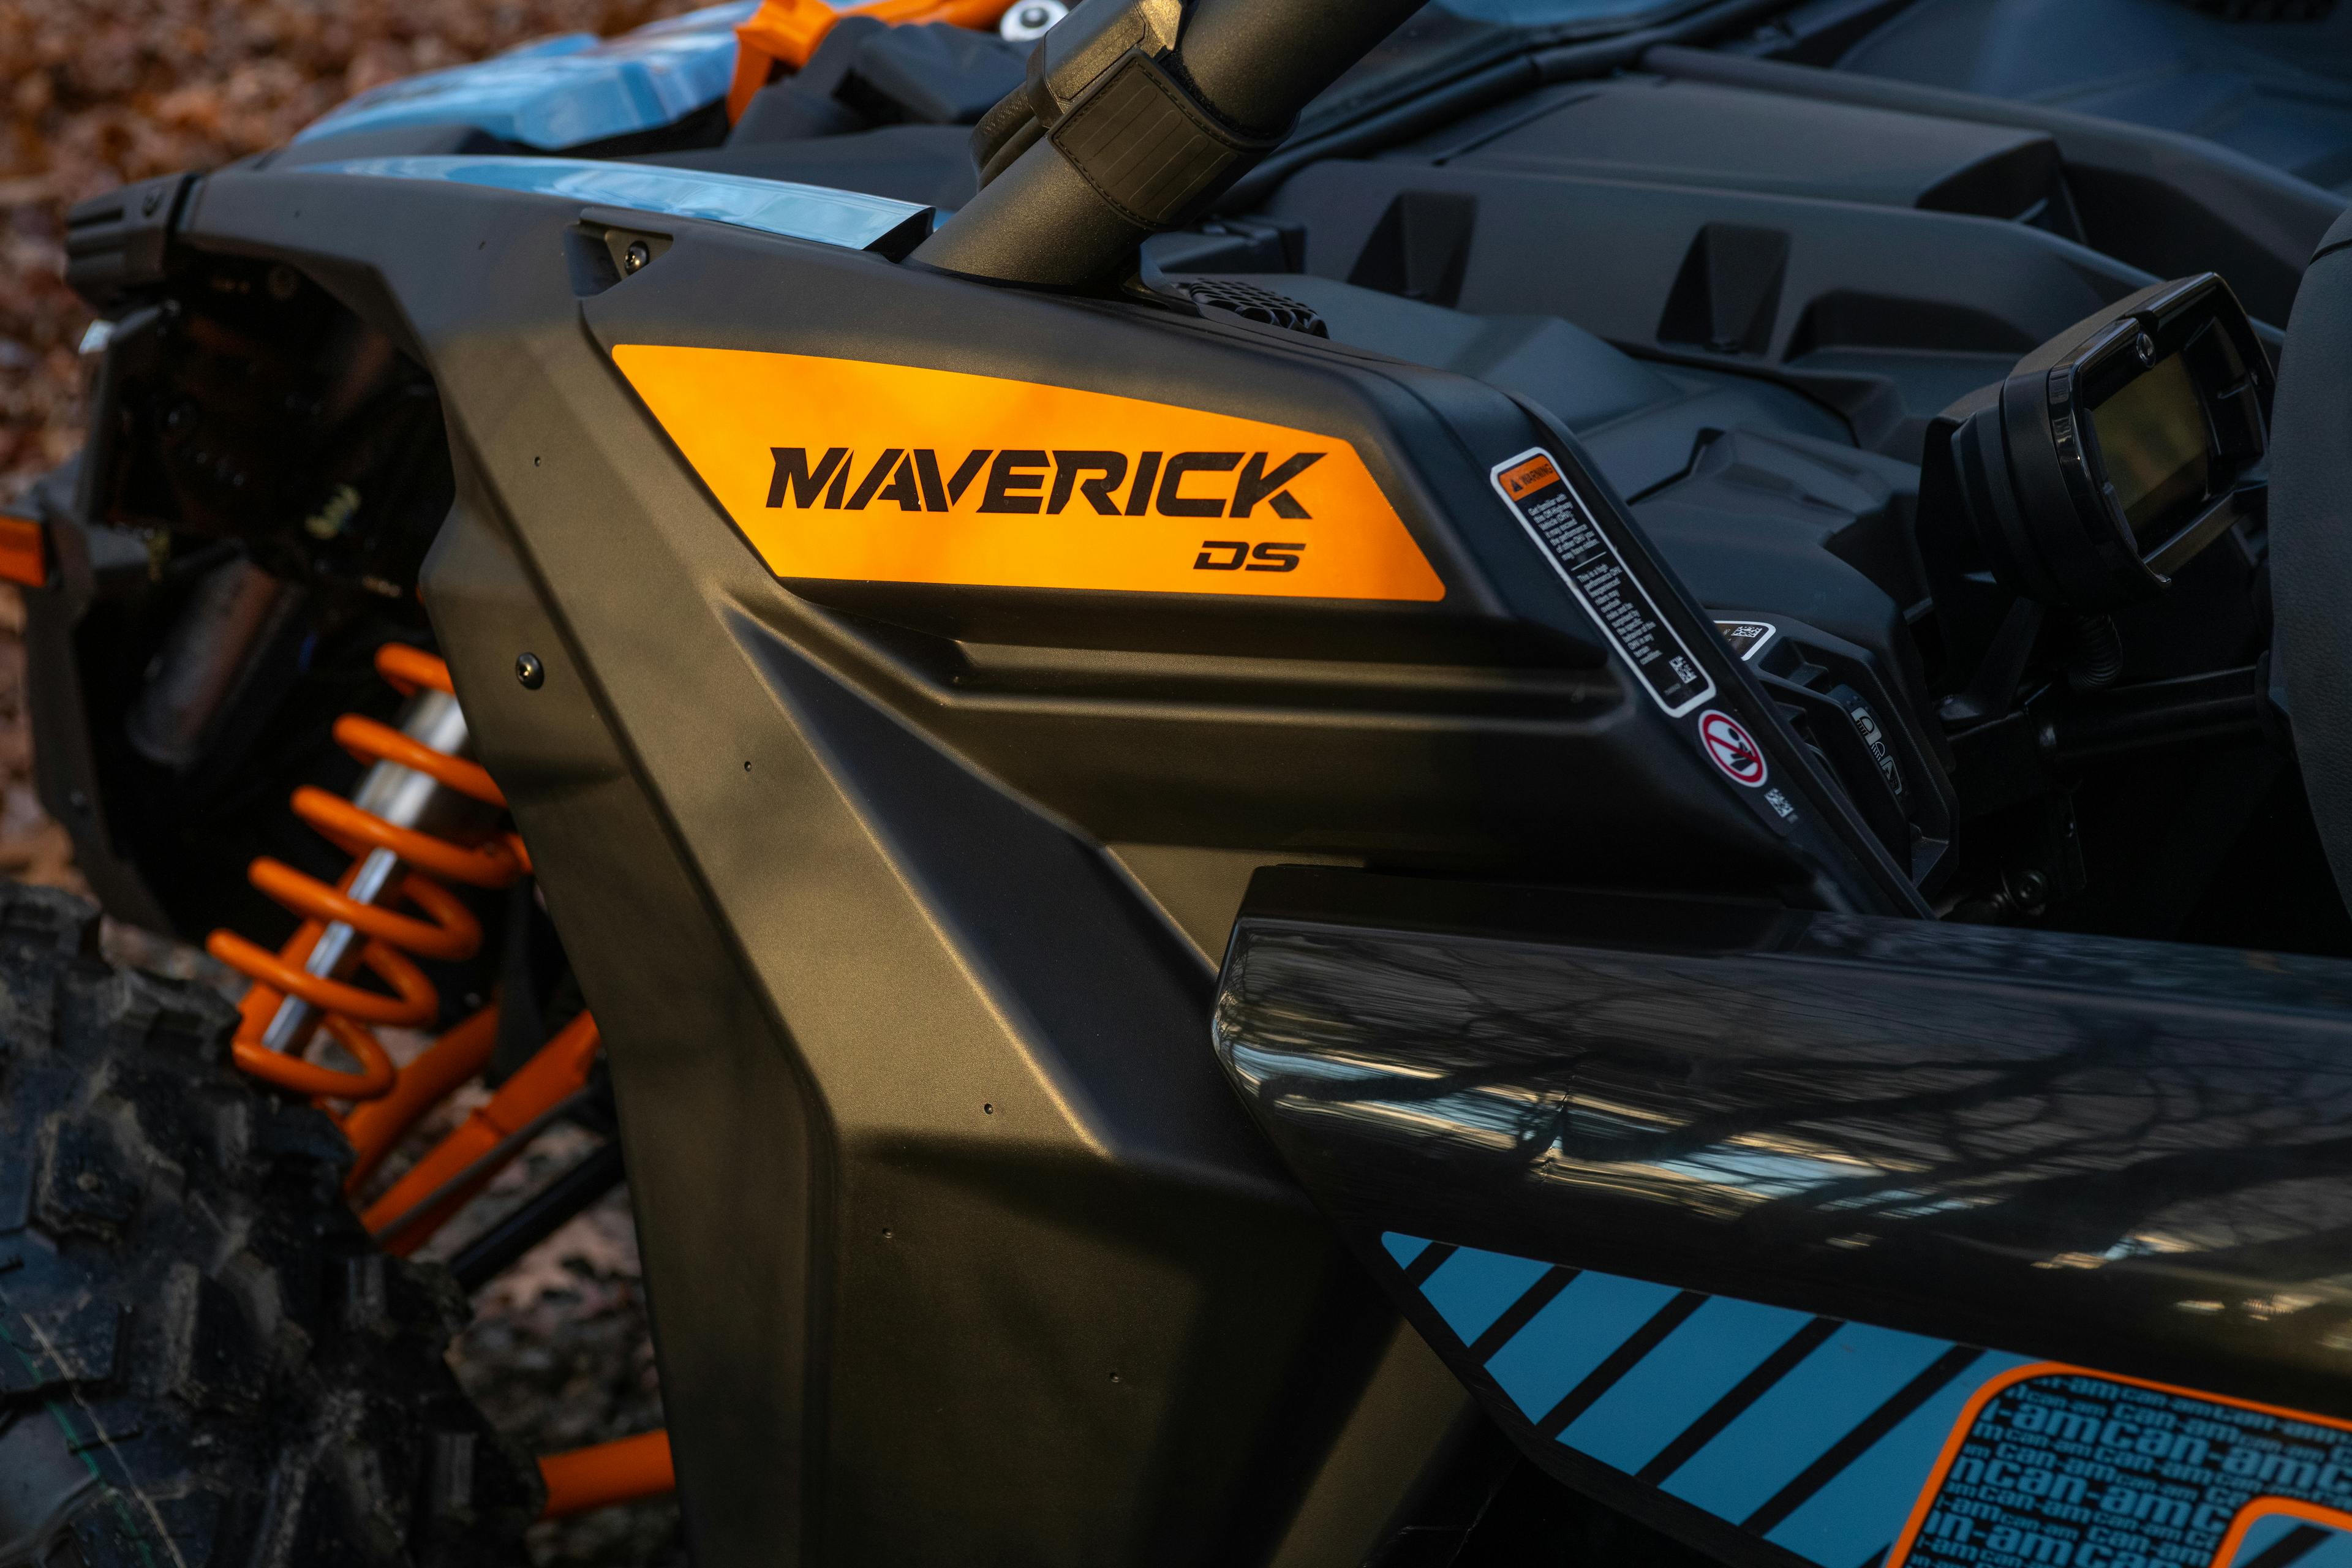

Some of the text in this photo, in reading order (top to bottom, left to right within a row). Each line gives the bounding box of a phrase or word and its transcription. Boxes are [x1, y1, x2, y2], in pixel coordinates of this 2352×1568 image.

[766, 447, 1328, 519] MAVERICK
[1519, 464, 1553, 485] WARNING
[1193, 541, 1306, 572] DS
[2113, 1401, 2241, 1444] can-am
[1996, 1442, 2116, 1482] can-am
[2093, 1446, 2214, 1485] can-am
[2100, 1419, 2318, 1489] can-am
[1978, 1485, 2092, 1524] can-am
[1983, 1459, 2192, 1529] can-am
